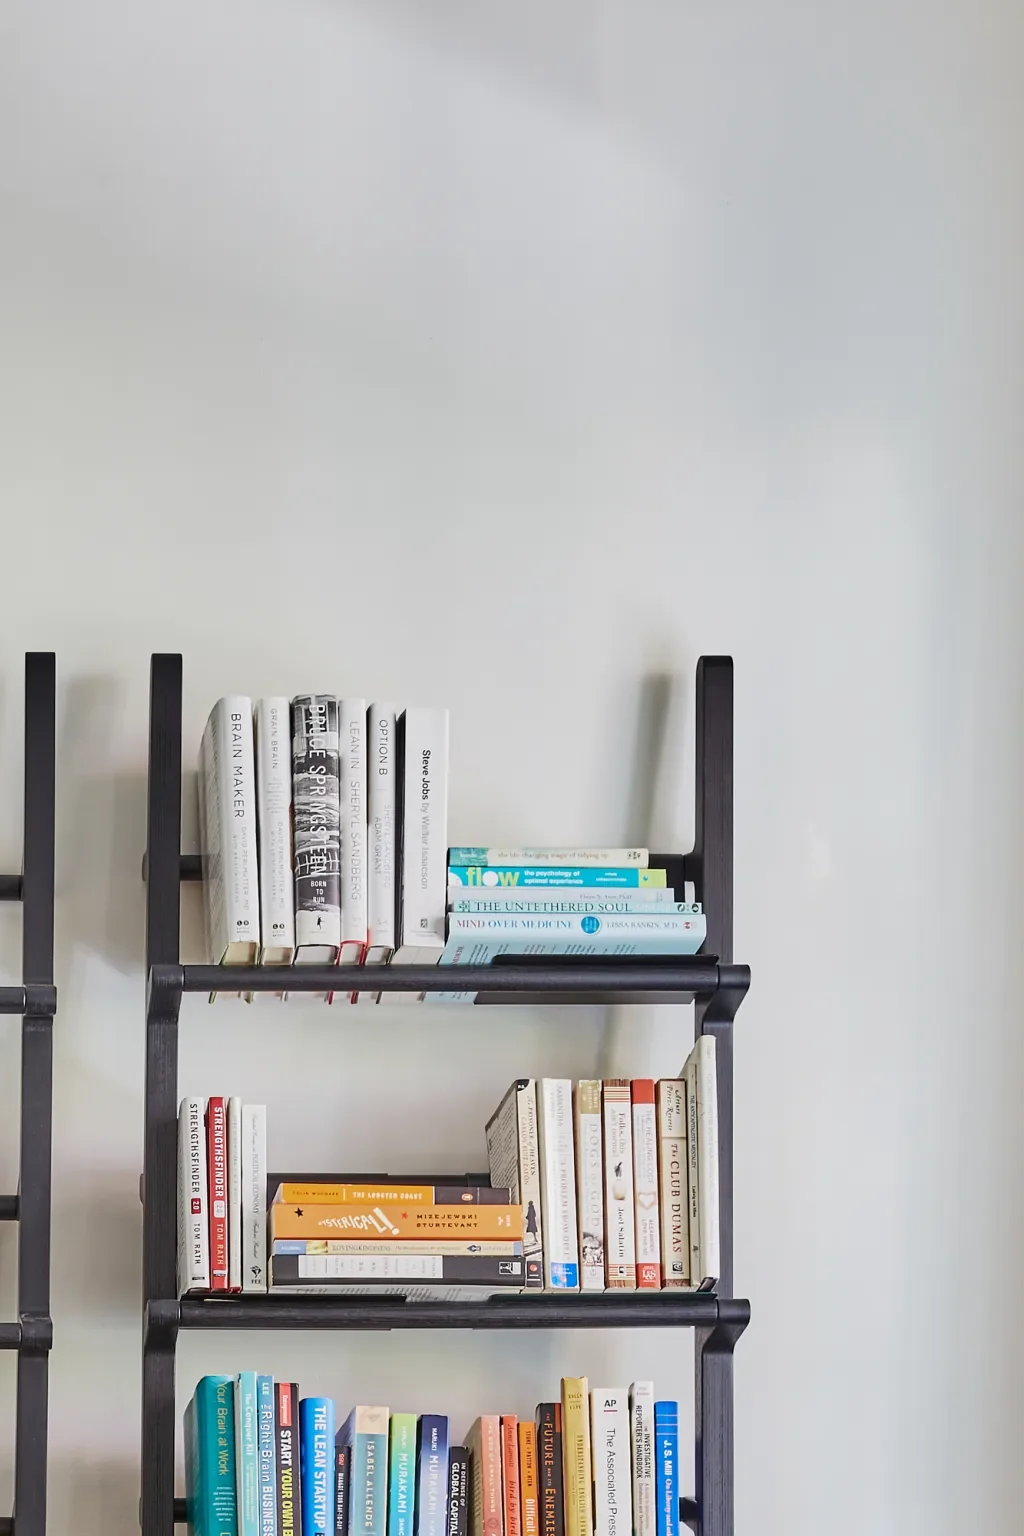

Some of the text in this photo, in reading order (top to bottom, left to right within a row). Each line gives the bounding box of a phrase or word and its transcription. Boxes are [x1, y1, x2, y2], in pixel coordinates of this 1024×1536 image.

[379, 719, 388, 762] OPTION
[231, 713, 244, 818] BRAIN MAKER
[421, 749, 431, 800] Steve Jobs
[309, 705, 327, 876] BRUCE SPRINGSTEEN
[476, 902, 632, 912] THE UNTETHERED SOUL
[190, 1104, 199, 1193] STRENGTHSFINDER
[671, 1144, 681, 1252] The CLUB DUMAS
[217, 1383, 228, 1475] Your Brain at Work
[314, 1406, 326, 1430] THE
[606, 1428, 616, 1448] The
[261, 1411, 271, 1481] Right-Brain
[281, 1430, 292, 1466] START
[314, 1434, 326, 1467] LEAN
[544, 1423, 554, 1465] FUTURE
[635, 1405, 644, 1479] REPORTER'S HANDBOOK
[281, 1468, 293, 1498] YOUR
[451, 1462, 460, 1498] GLOBAL
[607, 1450, 617, 1504] Associated
[282, 1501, 293, 1527] OWN
[314, 1471, 326, 1528] STARTUP
[525, 1499, 536, 1532] Difficult
[608, 1508, 618, 1536] Press
